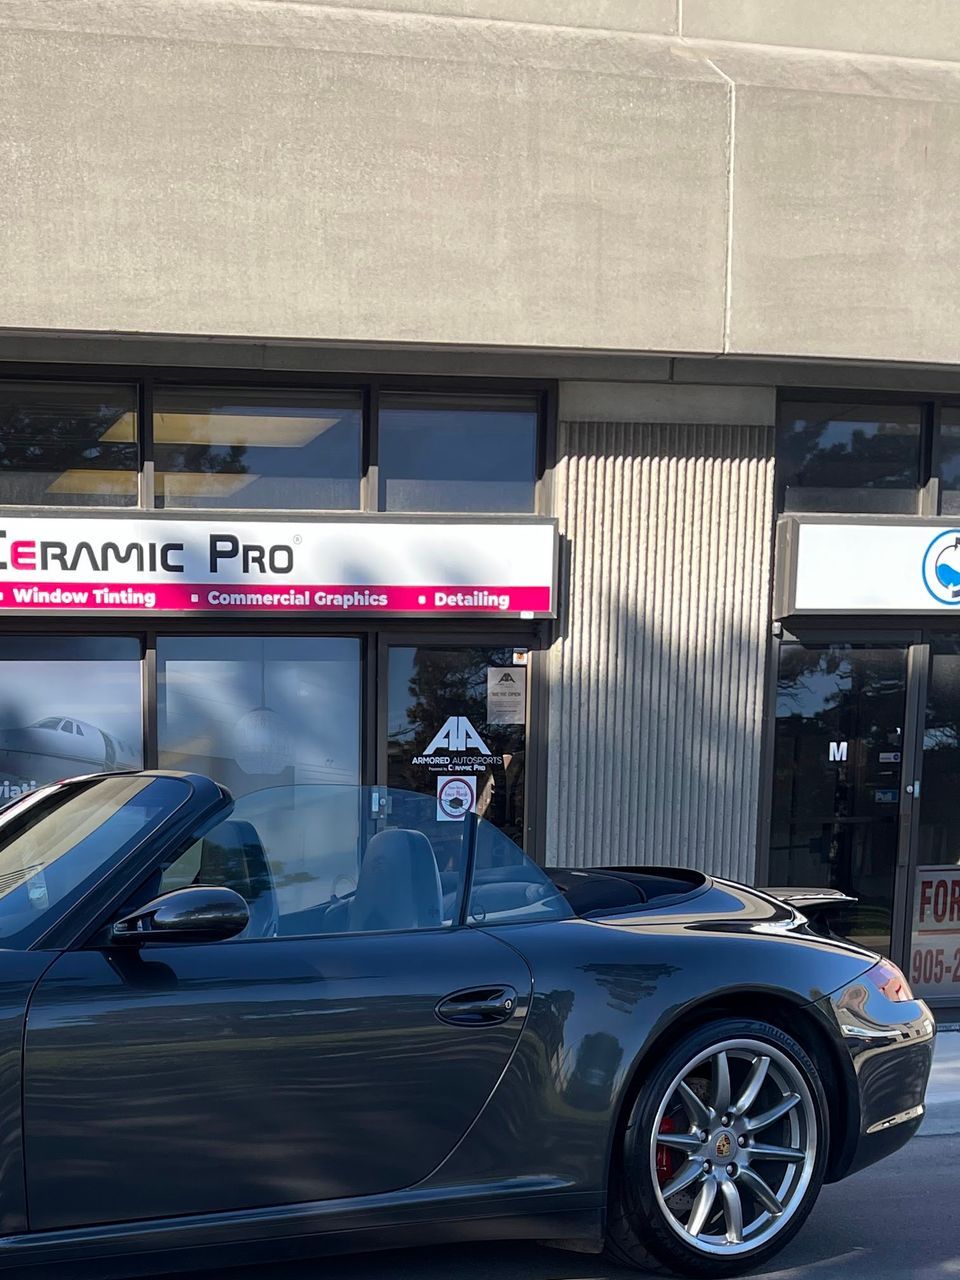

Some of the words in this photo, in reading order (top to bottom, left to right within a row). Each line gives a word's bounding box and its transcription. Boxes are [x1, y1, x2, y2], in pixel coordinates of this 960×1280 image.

[209, 534, 294, 574] PRO
[13, 587, 88, 605] Window
[92, 588, 157, 607] Tinting
[207, 590, 310, 608] Commercial
[314, 590, 388, 610] Graphics
[434, 591, 510, 610] Detailing
[412, 757, 450, 765] ARMORED
[452, 757, 502, 765] AUTOSPORTS
[829, 741, 848, 761] M
[918, 879, 960, 923] FOR
